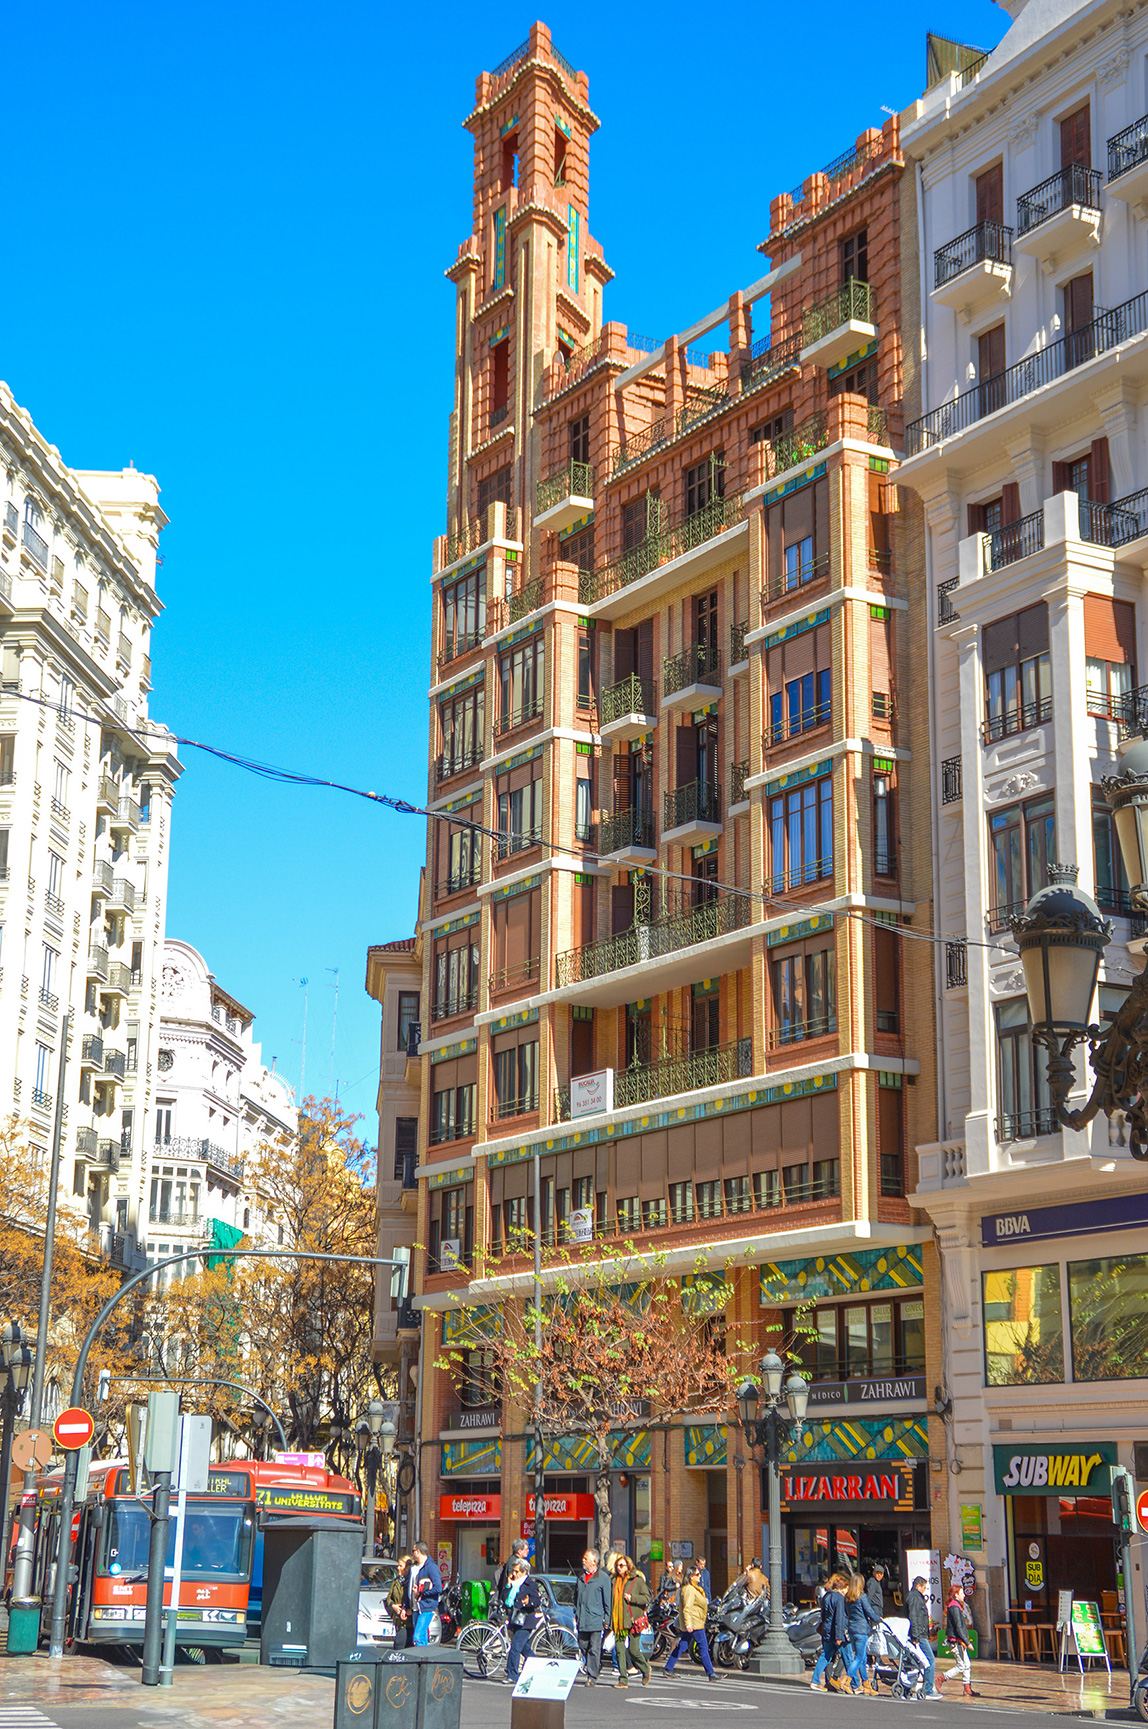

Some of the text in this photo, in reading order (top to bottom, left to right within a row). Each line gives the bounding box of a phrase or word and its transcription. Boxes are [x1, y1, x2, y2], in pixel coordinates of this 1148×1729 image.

[996, 1215, 1031, 1236] BBVA
[811, 1381, 916, 1400] MÉDICO ZAHRAWI
[460, 1413, 495, 1427] ZAHRAWI
[1003, 1453, 1102, 1487] SUBWAY
[784, 1474, 899, 1500] LIZARRAN
[256, 1490, 272, 1505] 71
[274, 1497, 343, 1510] UNIVERSITATS
[452, 1499, 486, 1516] telepizza
[1027, 1563, 1041, 1571] SUB
